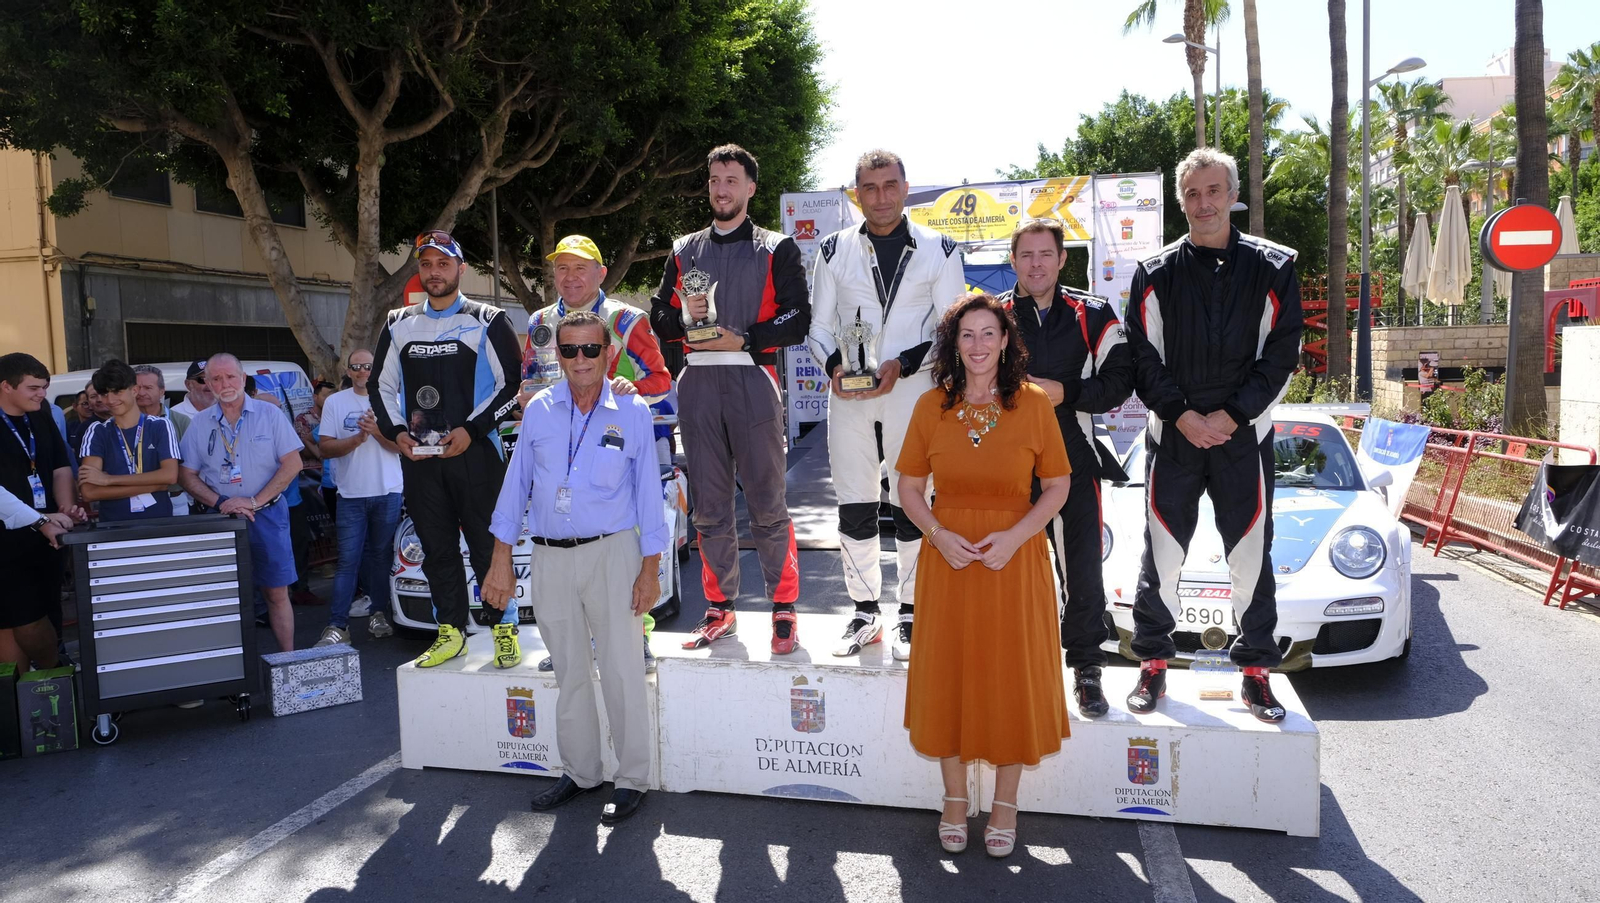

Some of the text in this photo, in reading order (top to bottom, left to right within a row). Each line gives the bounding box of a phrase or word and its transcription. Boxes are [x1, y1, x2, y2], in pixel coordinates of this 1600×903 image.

[802, 198, 840, 208] ALMERÍA
[950, 194, 977, 216] 49
[928, 213, 1005, 227] RALLYE COSTA DE ALMERÍA
[1267, 251, 1283, 263] OMP
[1147, 258, 1162, 269] OMP
[408, 343, 458, 354] ASTARS
[796, 379, 830, 393] TOD
[1178, 607, 1224, 625] 2690
[497, 741, 549, 752] DIPUTACIÓN
[512, 751, 548, 761] ALMERÍA
[758, 756, 862, 777] DE ALMERÍA
[1115, 787, 1171, 797] DIPUTACIÓN
[1131, 797, 1170, 806] ALMERÍA
